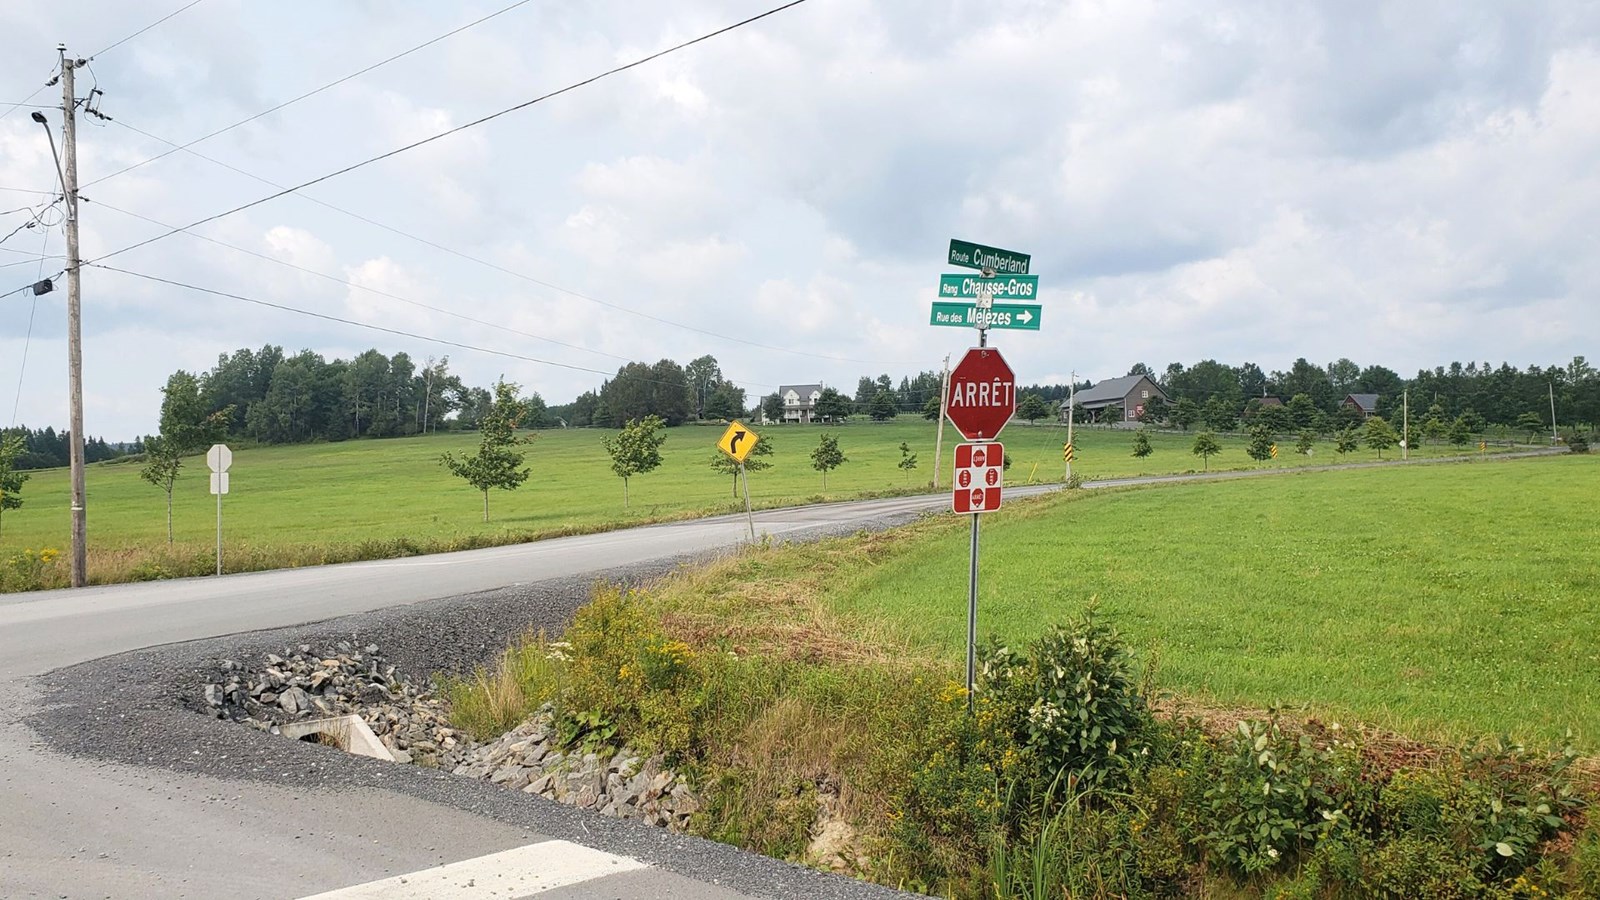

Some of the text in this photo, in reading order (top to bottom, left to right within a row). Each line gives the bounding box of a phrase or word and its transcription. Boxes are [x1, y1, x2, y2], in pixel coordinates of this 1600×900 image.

[951, 249, 1028, 274] Route Cumberland
[943, 279, 1033, 296] Rang Chausse-Gros
[936, 308, 1011, 325] Rue des Mélèzes
[951, 377, 1012, 407] ARRÊT
